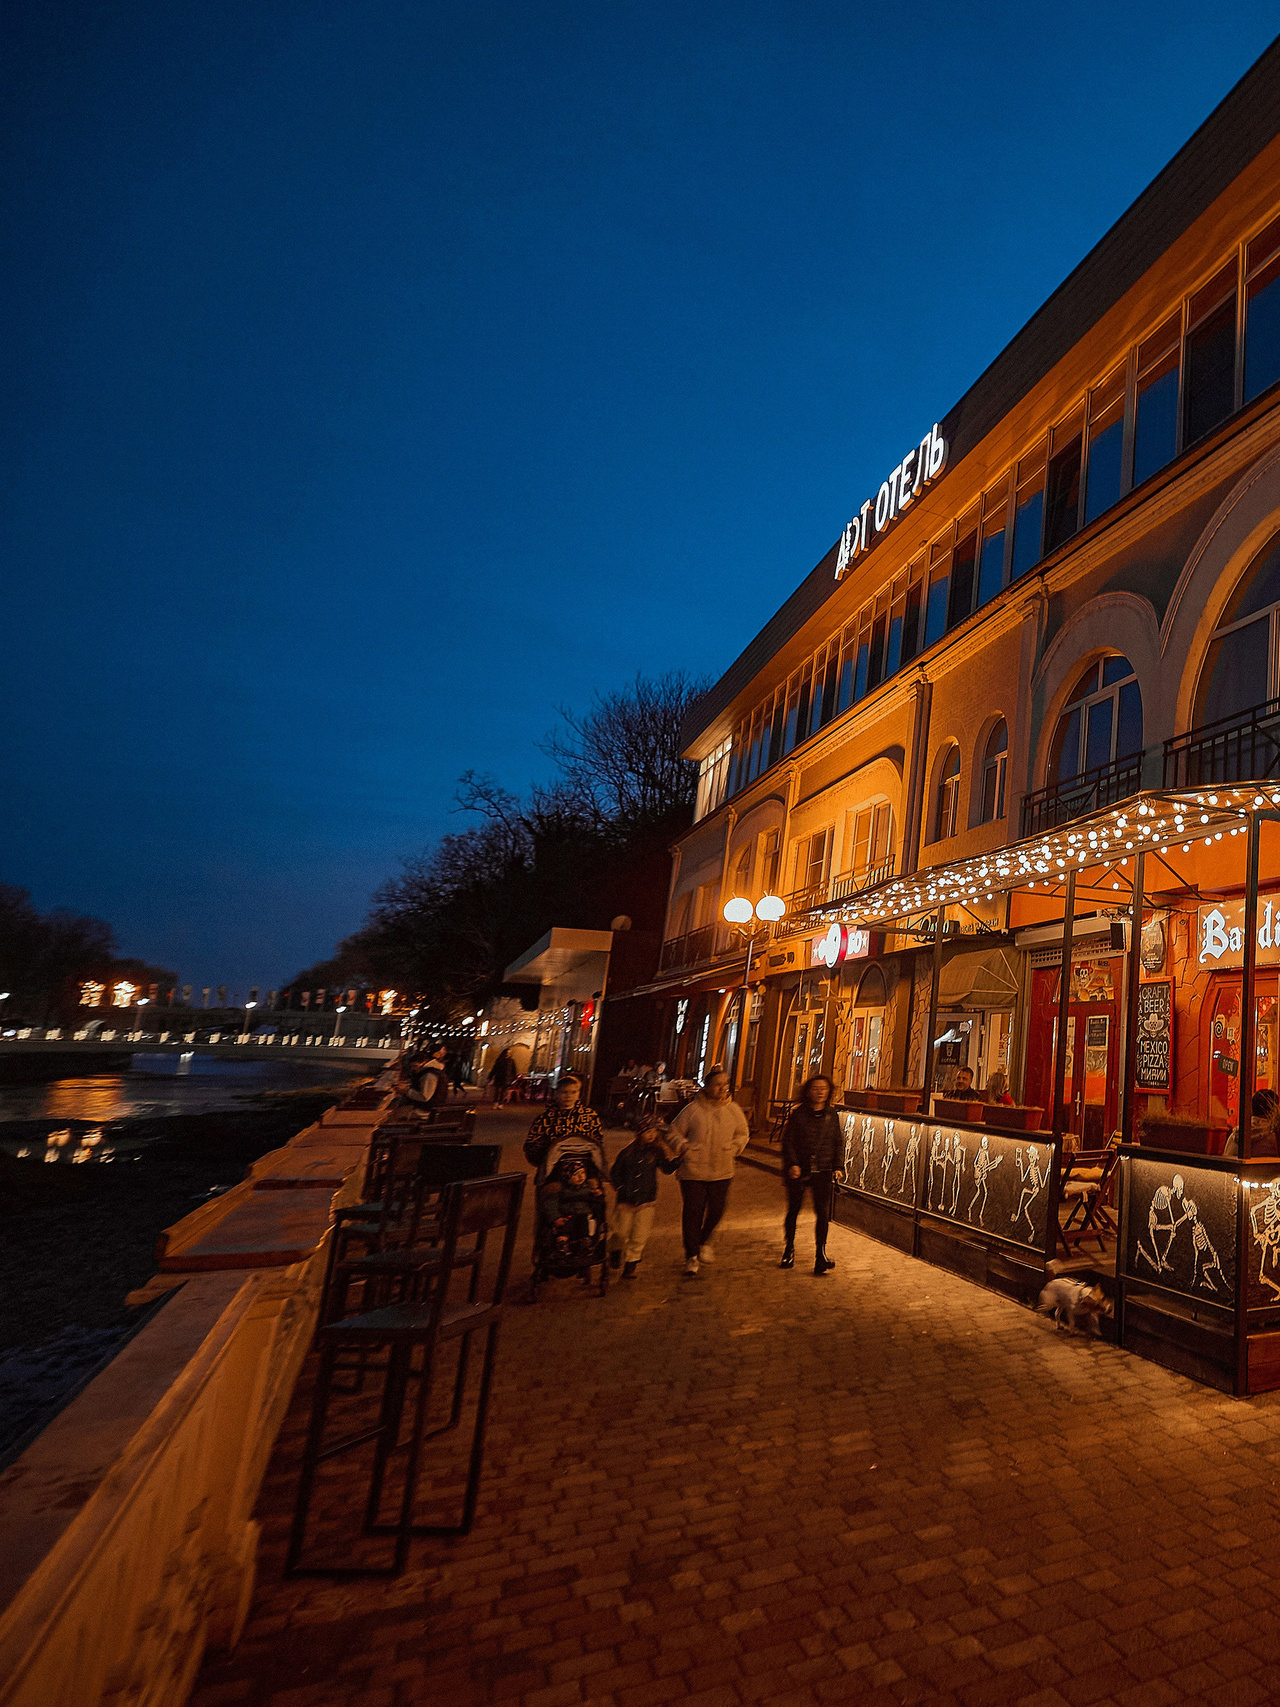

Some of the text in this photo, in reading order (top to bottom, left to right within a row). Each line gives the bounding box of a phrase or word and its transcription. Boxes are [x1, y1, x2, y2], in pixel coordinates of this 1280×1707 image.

[834, 422, 948, 580] АРТ ОТЕЛЬ
[1141, 985, 1169, 1000] CRAFT
[1144, 999, 1165, 1013] BEER
[1140, 1040, 1168, 1054] MEXICO
[1142, 1054, 1164, 1068] PIZZA
[1222, 1059, 1234, 1072] OPEN
